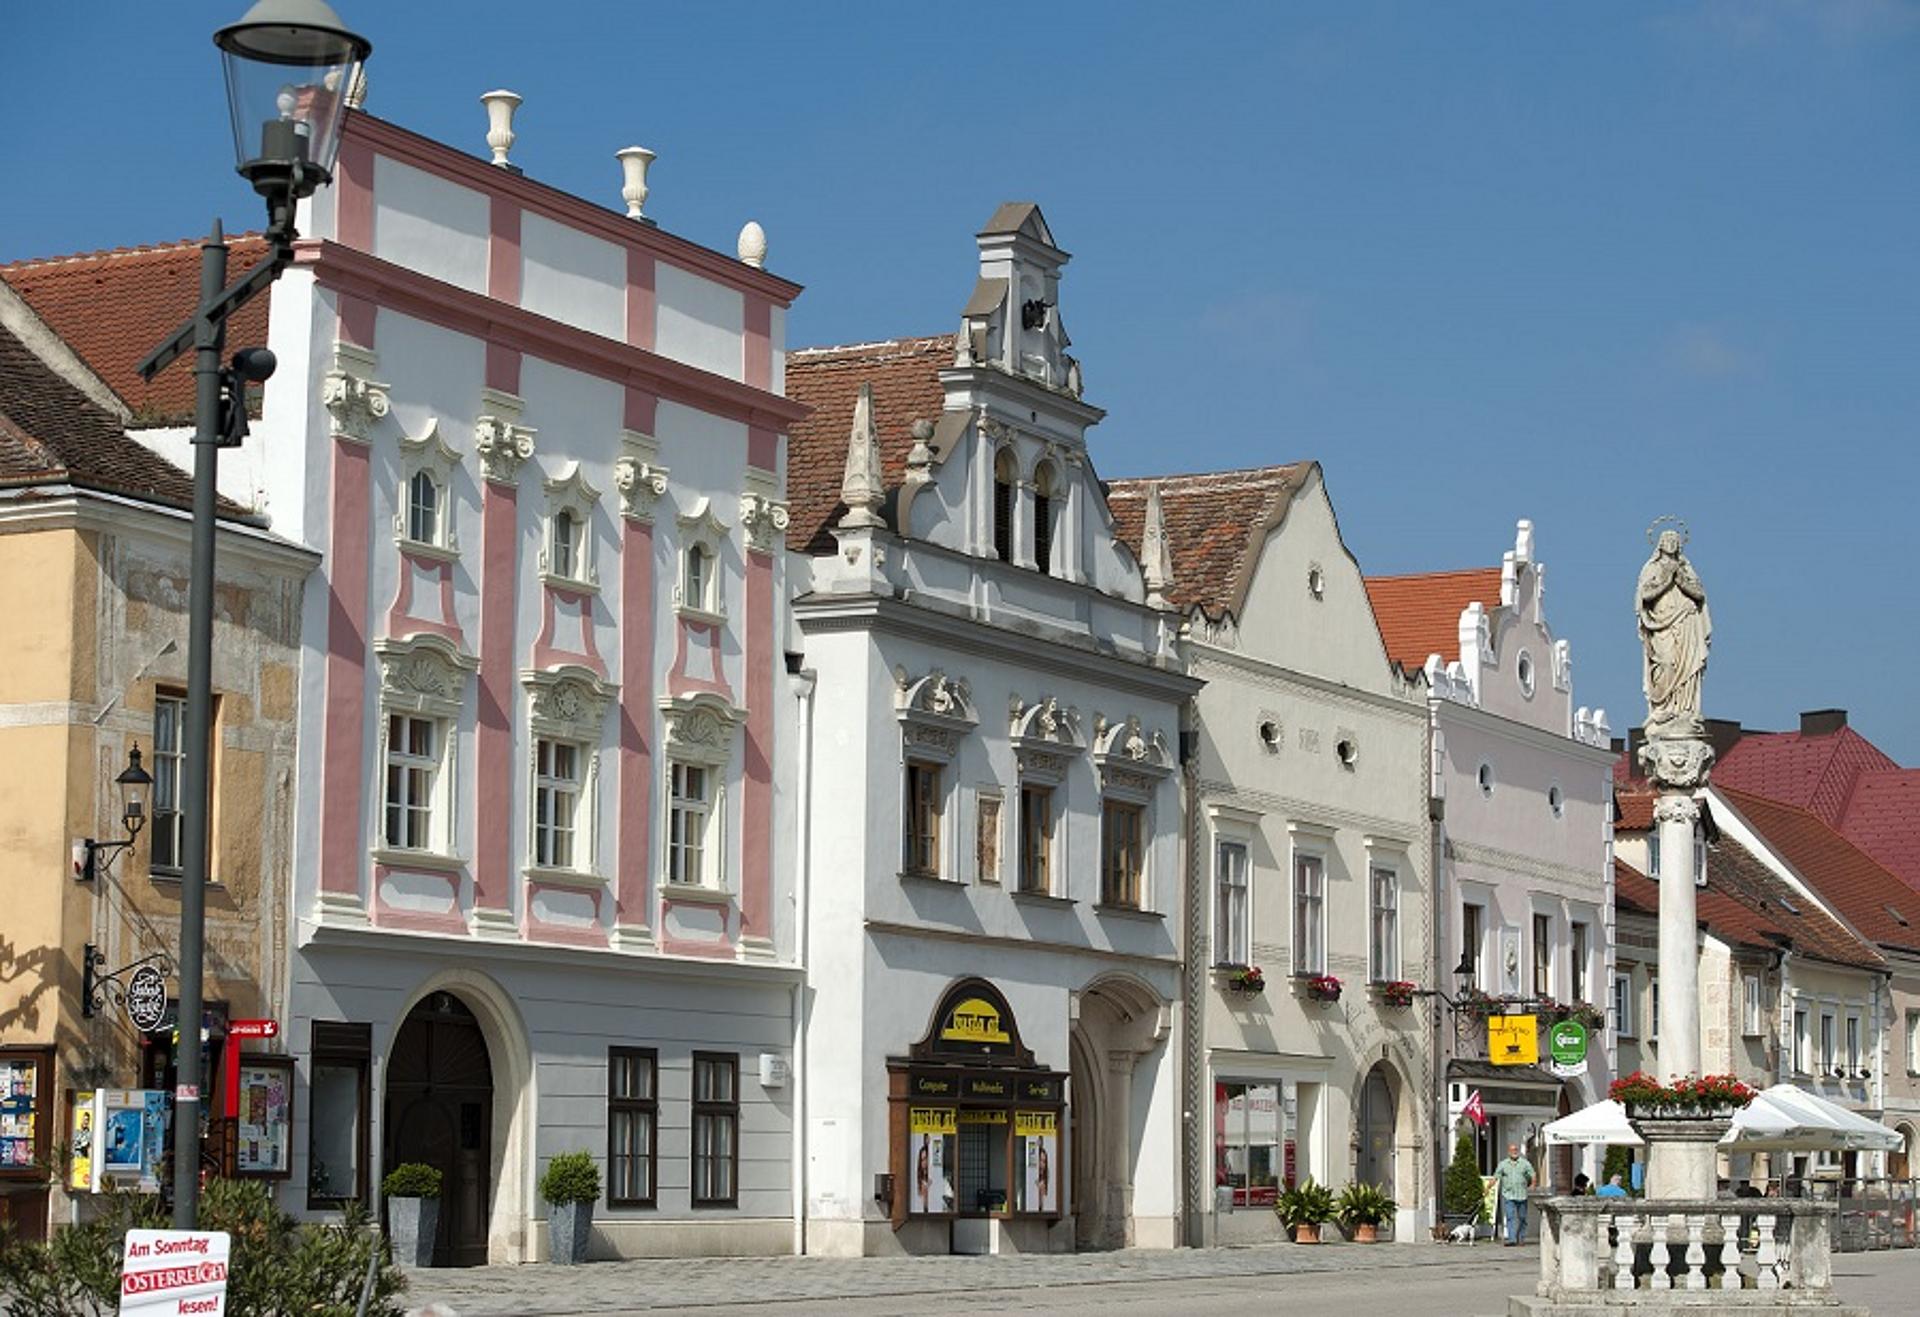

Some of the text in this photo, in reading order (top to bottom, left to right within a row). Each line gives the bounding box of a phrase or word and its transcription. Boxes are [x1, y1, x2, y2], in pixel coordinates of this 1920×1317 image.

[128, 1236, 209, 1257] Am Sonntag
[178, 1296, 219, 1314] lesen!
